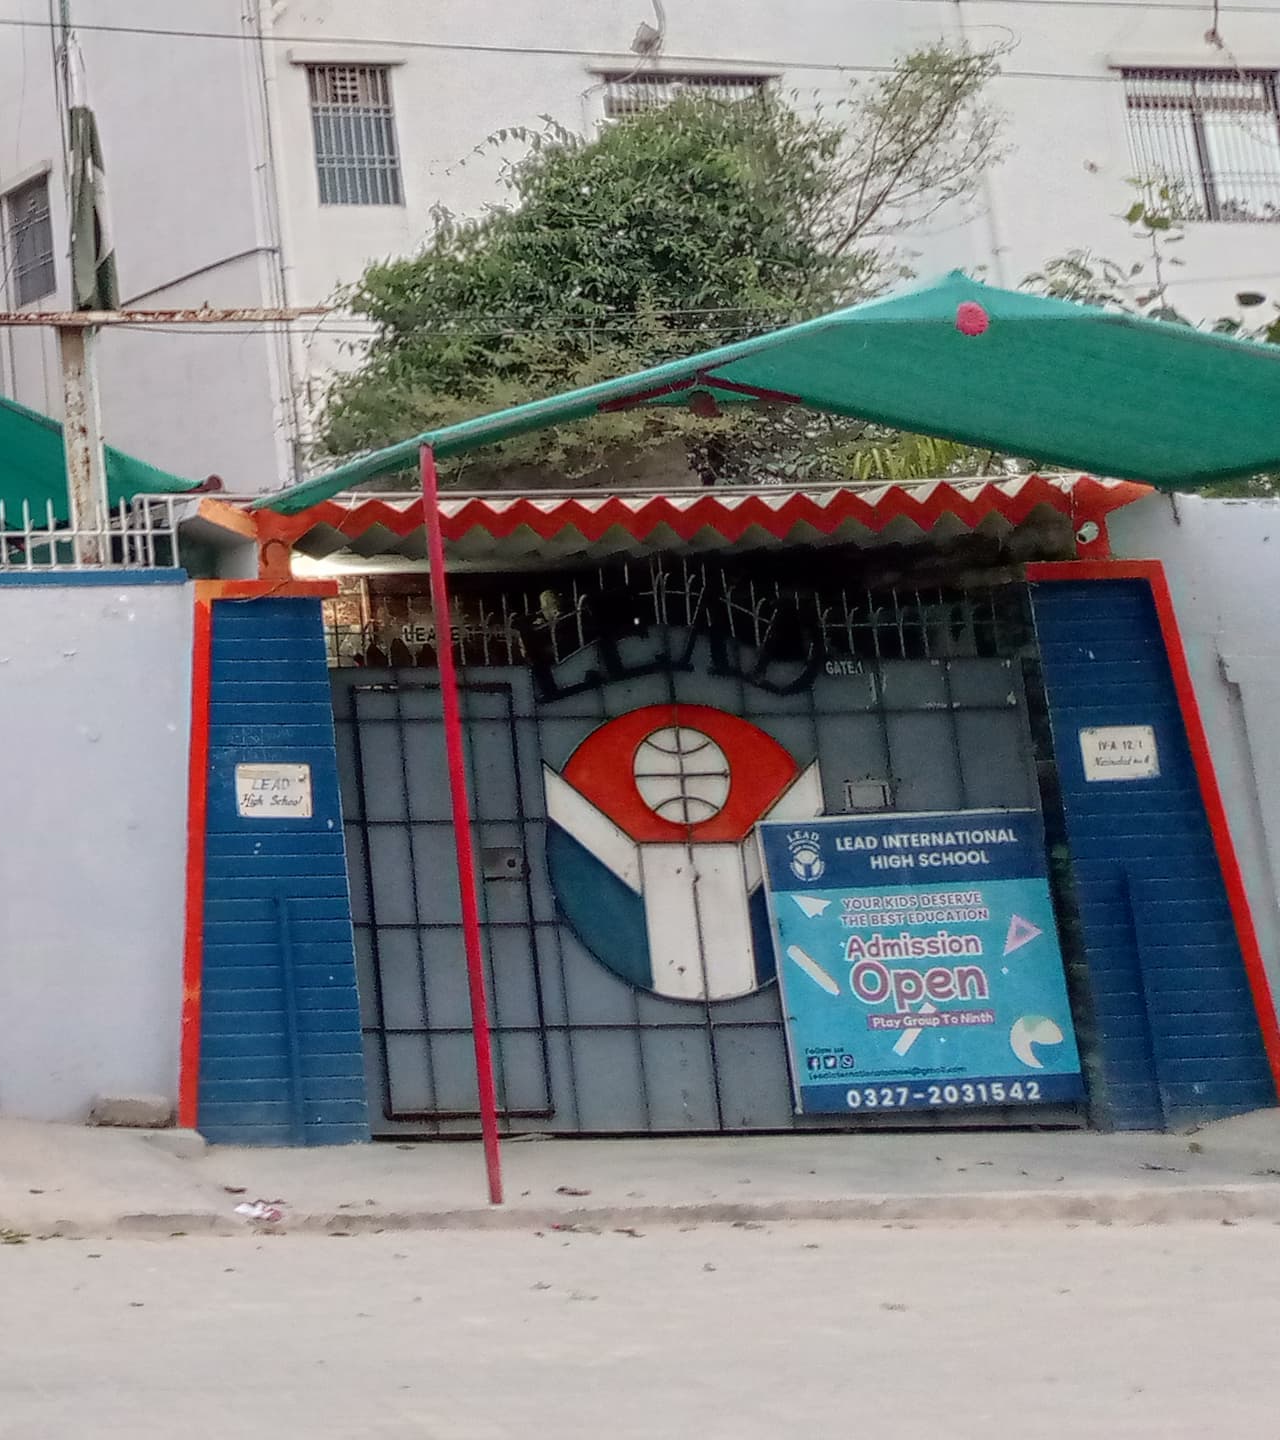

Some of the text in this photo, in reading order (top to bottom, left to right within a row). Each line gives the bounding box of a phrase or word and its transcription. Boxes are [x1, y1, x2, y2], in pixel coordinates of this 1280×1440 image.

[251, 777, 291, 792] LEAD
[836, 828, 1018, 852] LEAD INTERNATIONAL
[870, 850, 990, 870] HIGH SCHOOL
[843, 891, 982, 911] YOUR KIDS DESERVE
[841, 909, 989, 927] THE BEST EDUCATION
[845, 931, 983, 962] Admission
[850, 960, 990, 1013] Open
[872, 1012, 994, 1029] Play Group To Ninth
[845, 1081, 1042, 1109] 0327-2031542
